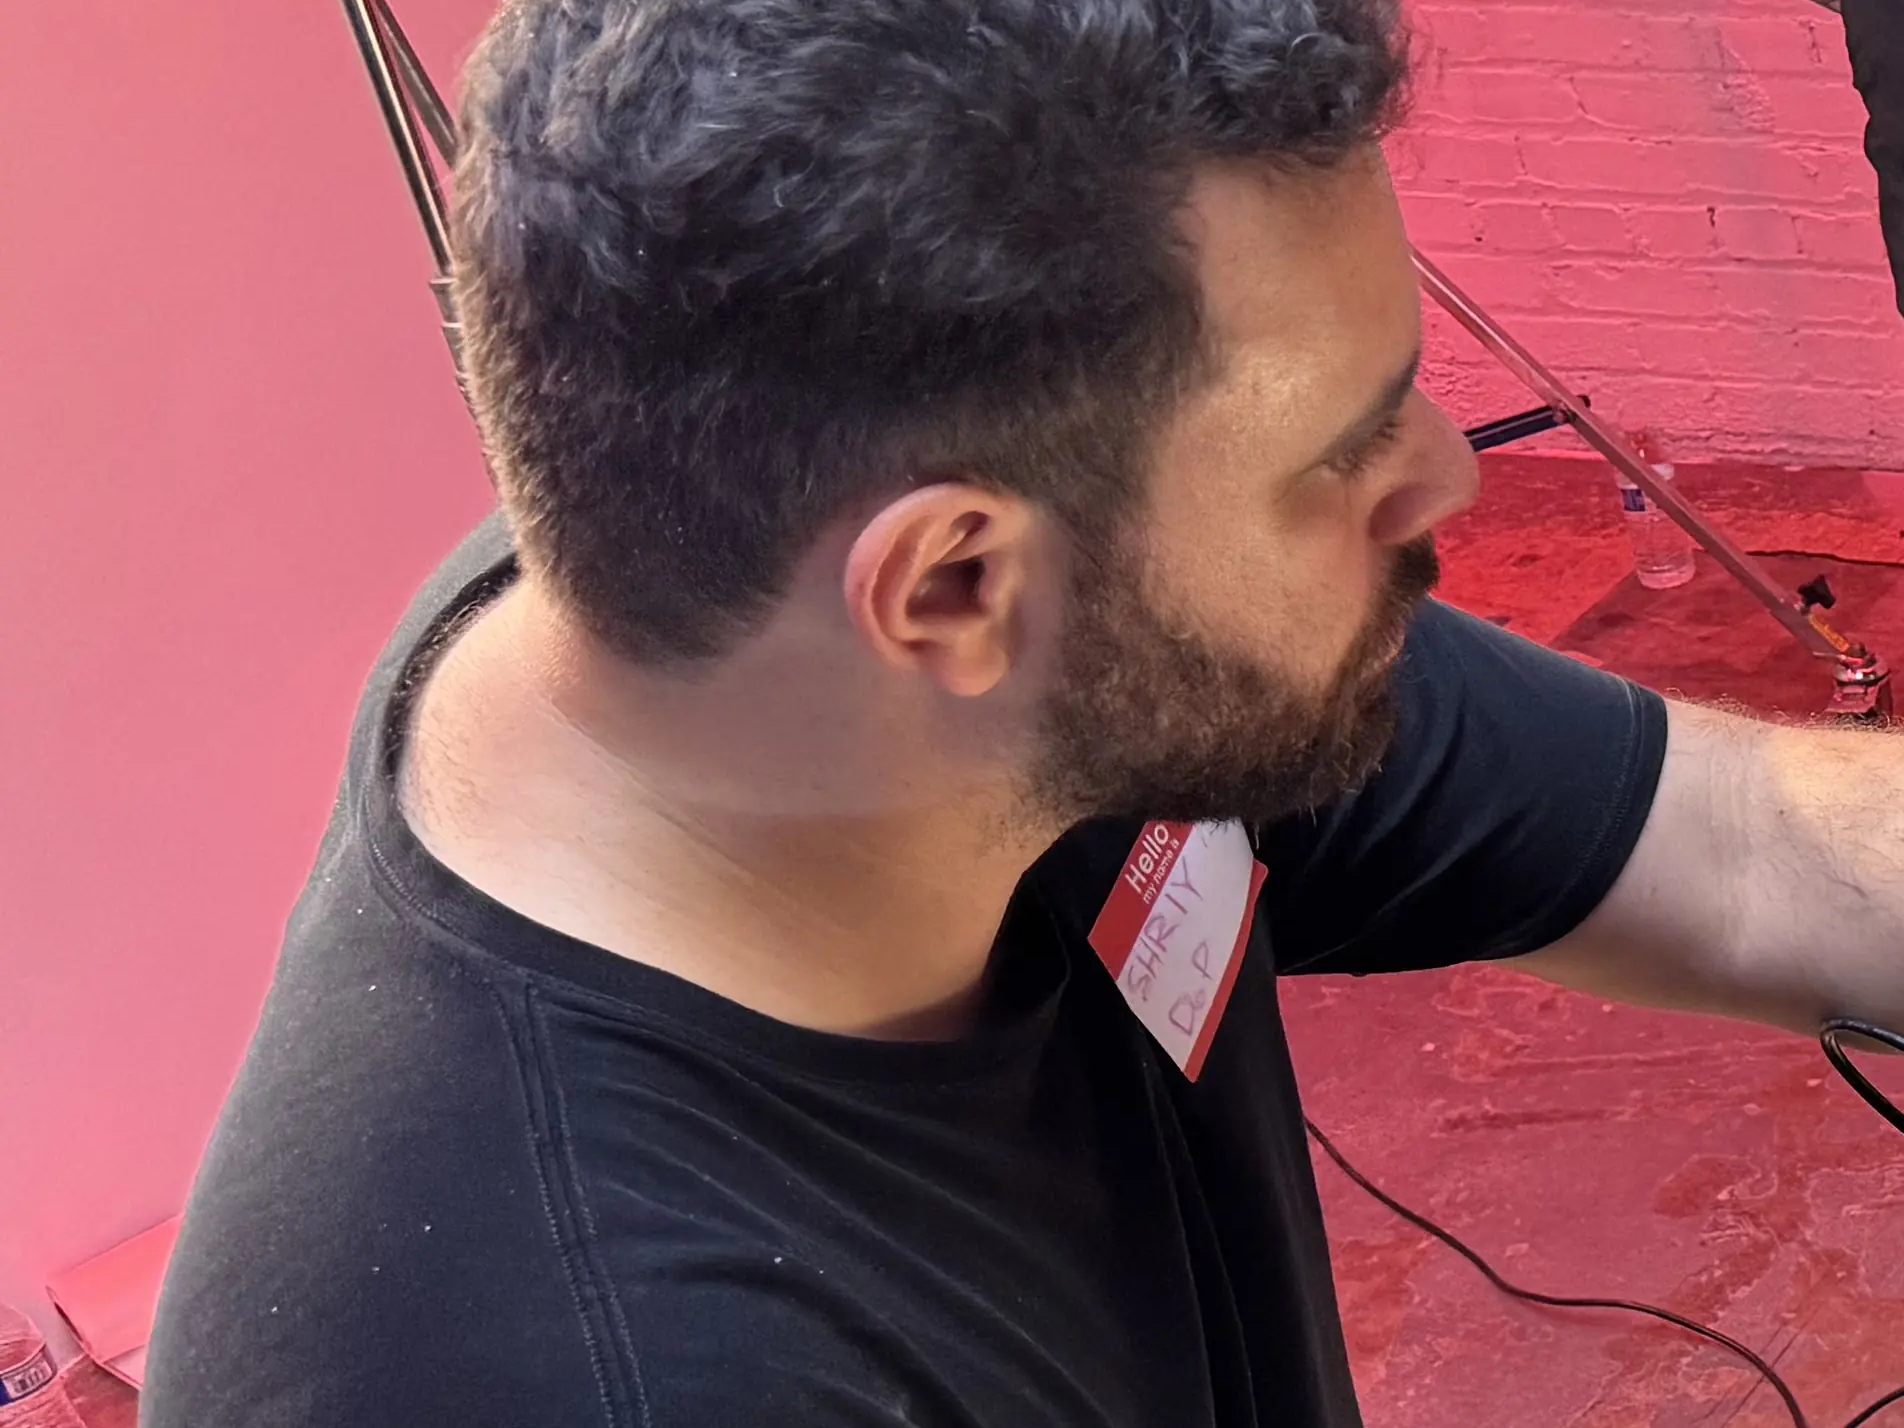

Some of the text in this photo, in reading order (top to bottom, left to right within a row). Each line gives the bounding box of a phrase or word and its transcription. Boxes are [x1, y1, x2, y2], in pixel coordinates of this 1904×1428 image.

[1125, 823, 1170, 894] Hello
[1142, 885, 1158, 905] my
[1153, 851, 1175, 886] name
